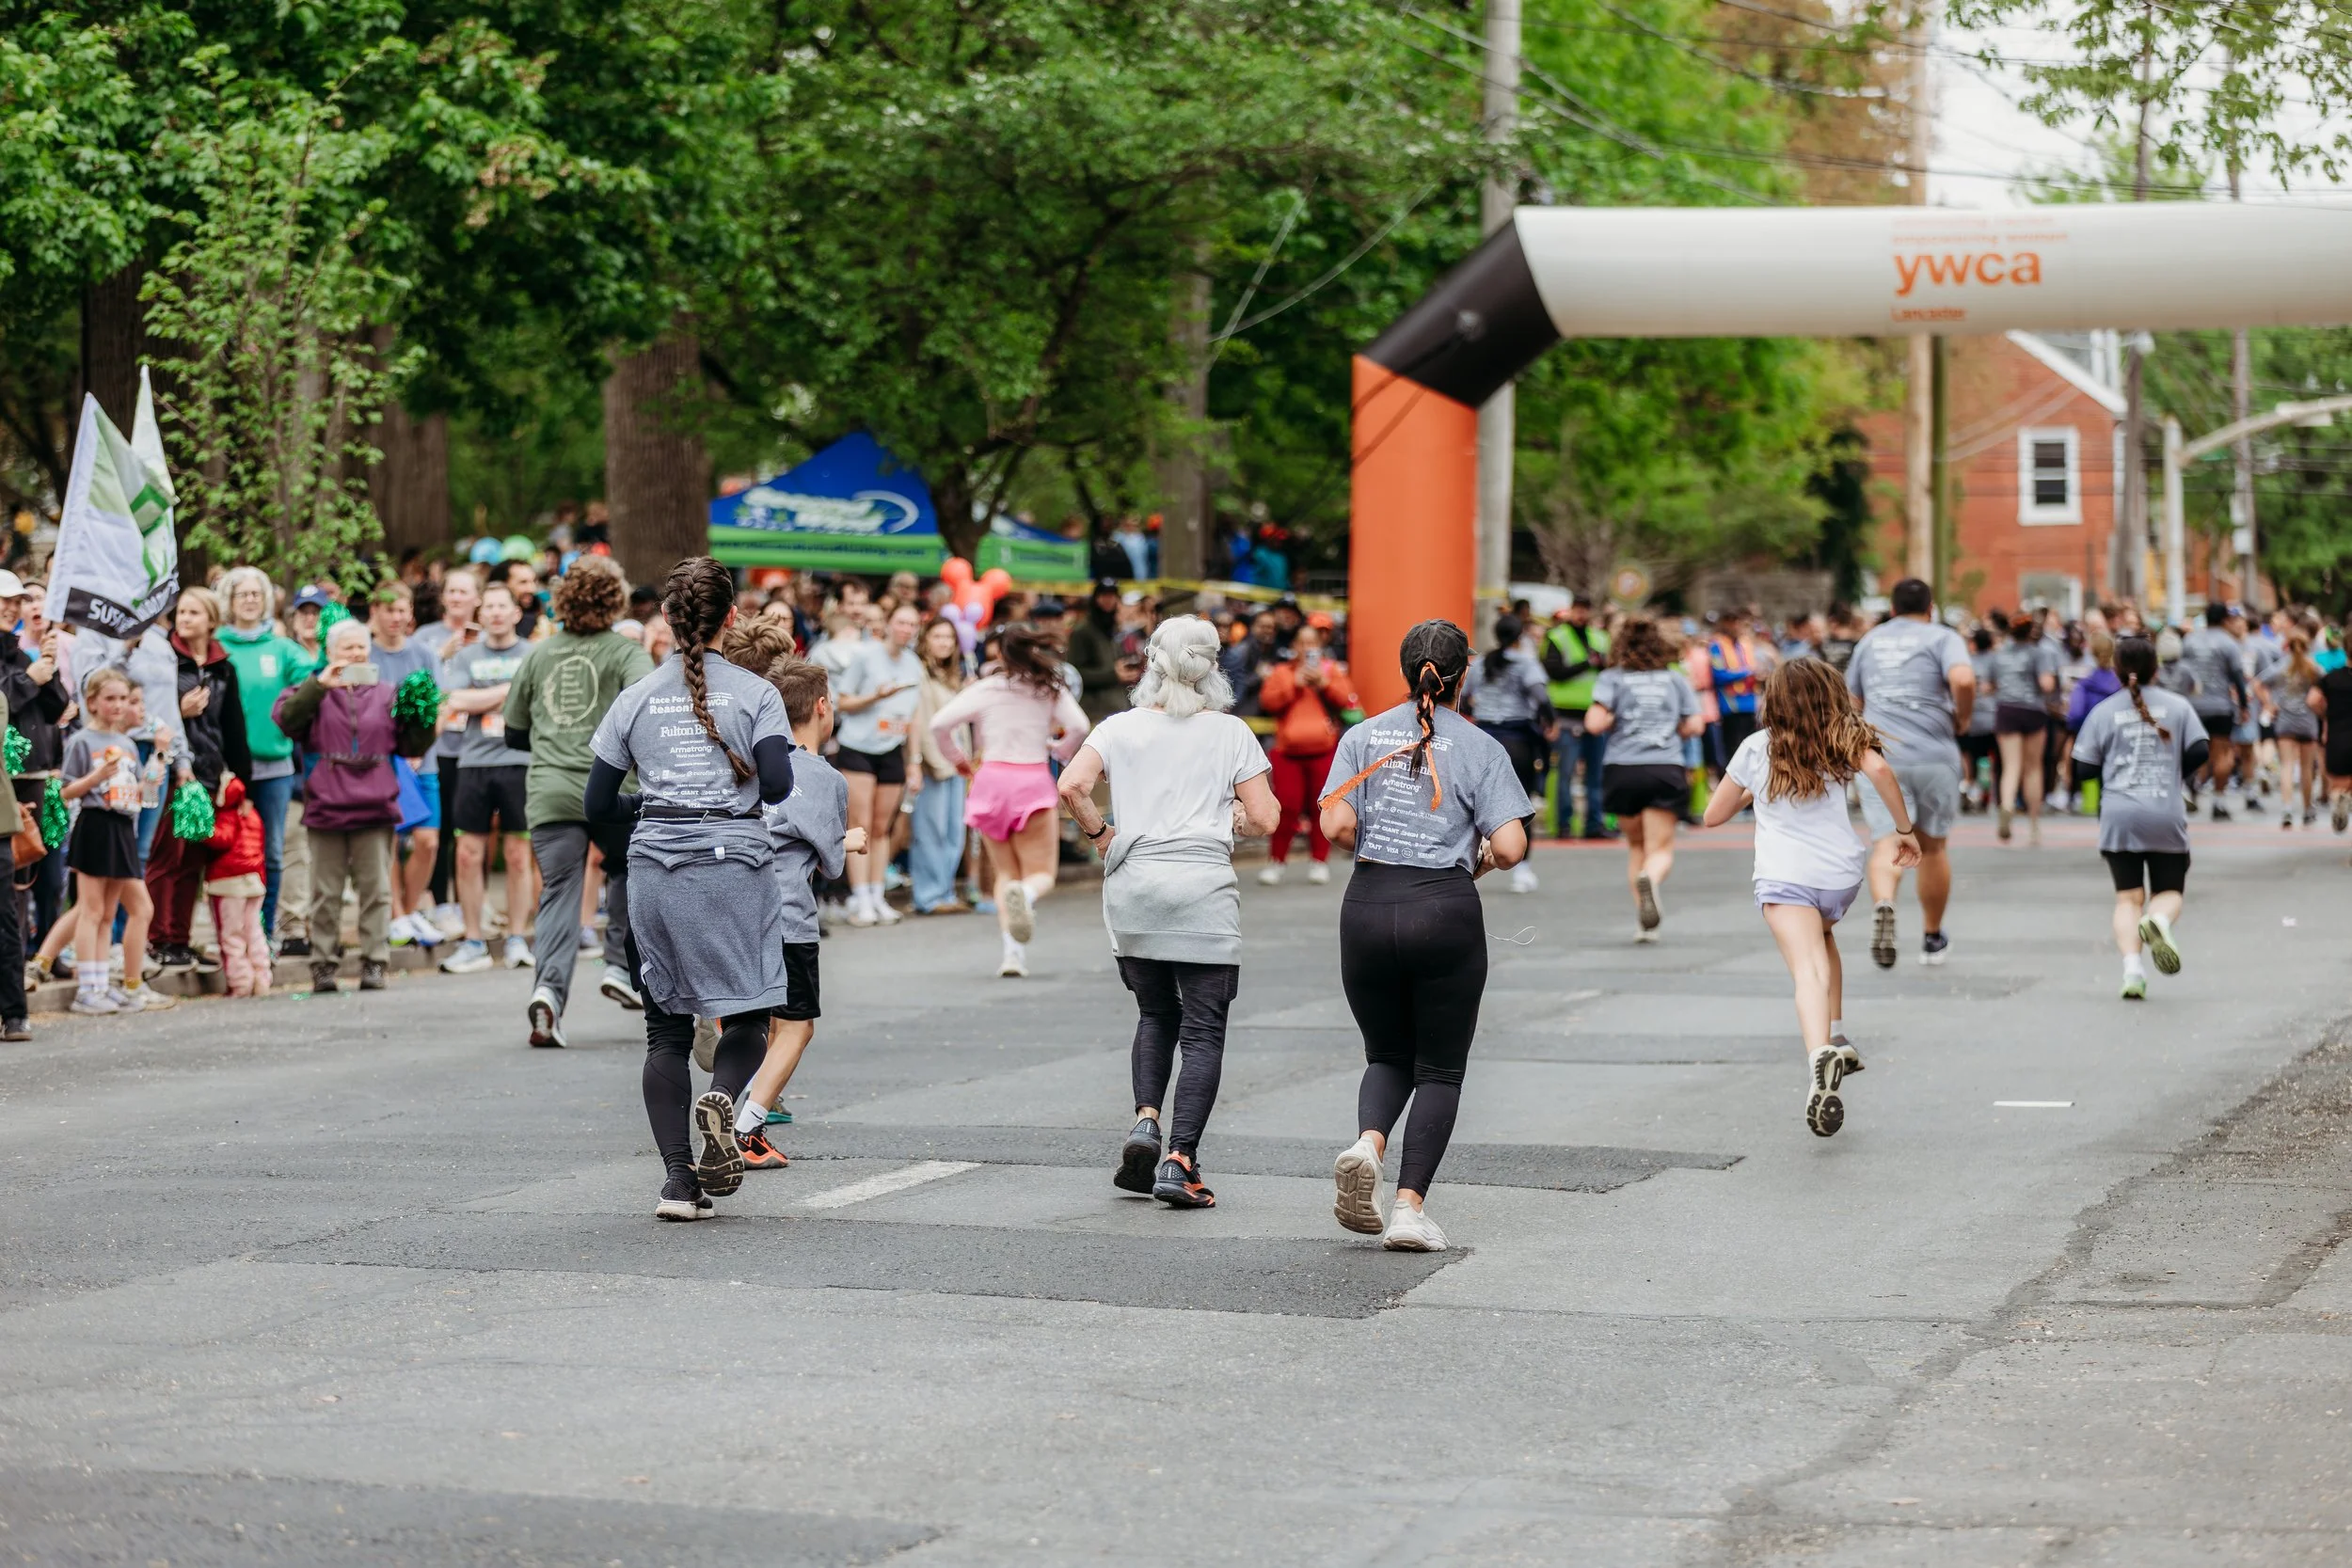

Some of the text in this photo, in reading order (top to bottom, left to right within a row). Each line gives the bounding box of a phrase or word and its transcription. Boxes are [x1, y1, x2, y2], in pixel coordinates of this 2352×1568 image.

[1894, 251, 2041, 297] ywca
[672, 695, 686, 704] For
[660, 723, 722, 737] Fulton Bak
[1371, 728, 1414, 738] Race For A
[1377, 757, 1409, 771] ulton
